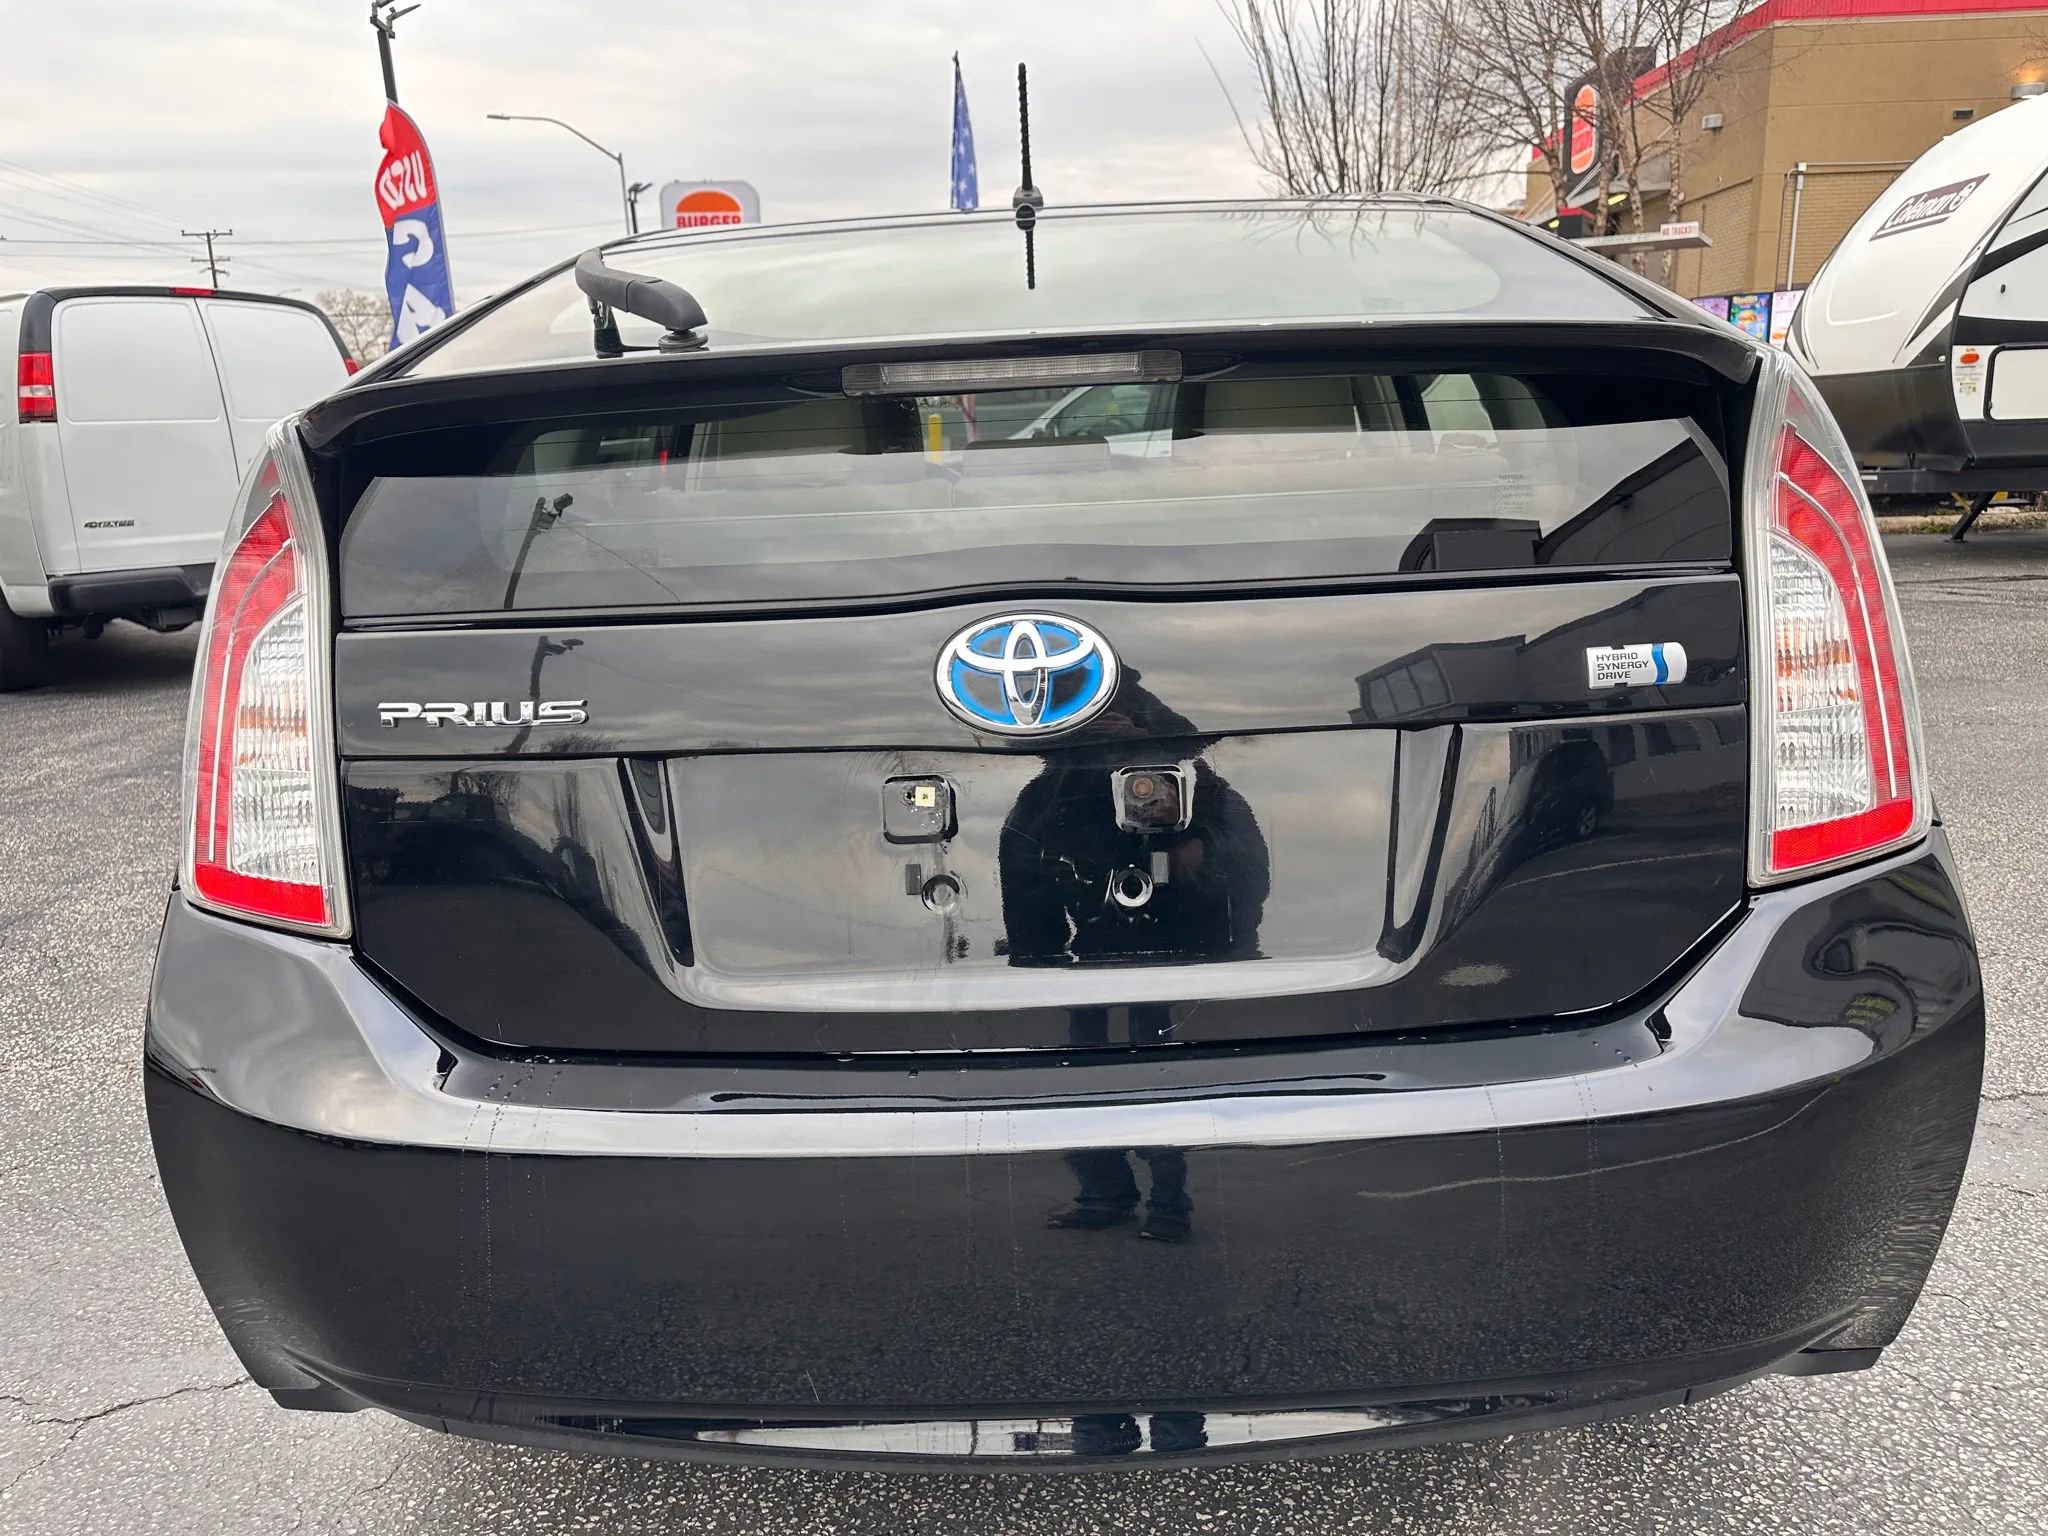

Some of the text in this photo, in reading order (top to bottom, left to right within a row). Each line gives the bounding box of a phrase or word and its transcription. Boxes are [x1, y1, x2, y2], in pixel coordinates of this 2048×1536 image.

[1884, 191, 1959, 229] Coleman
[676, 214, 742, 229] BURGER
[1596, 652, 1638, 662] HYBRID
[1597, 660, 1649, 671] SYNERGY
[1597, 671, 1631, 680] DRIVE
[378, 700, 589, 727] PRIUS
